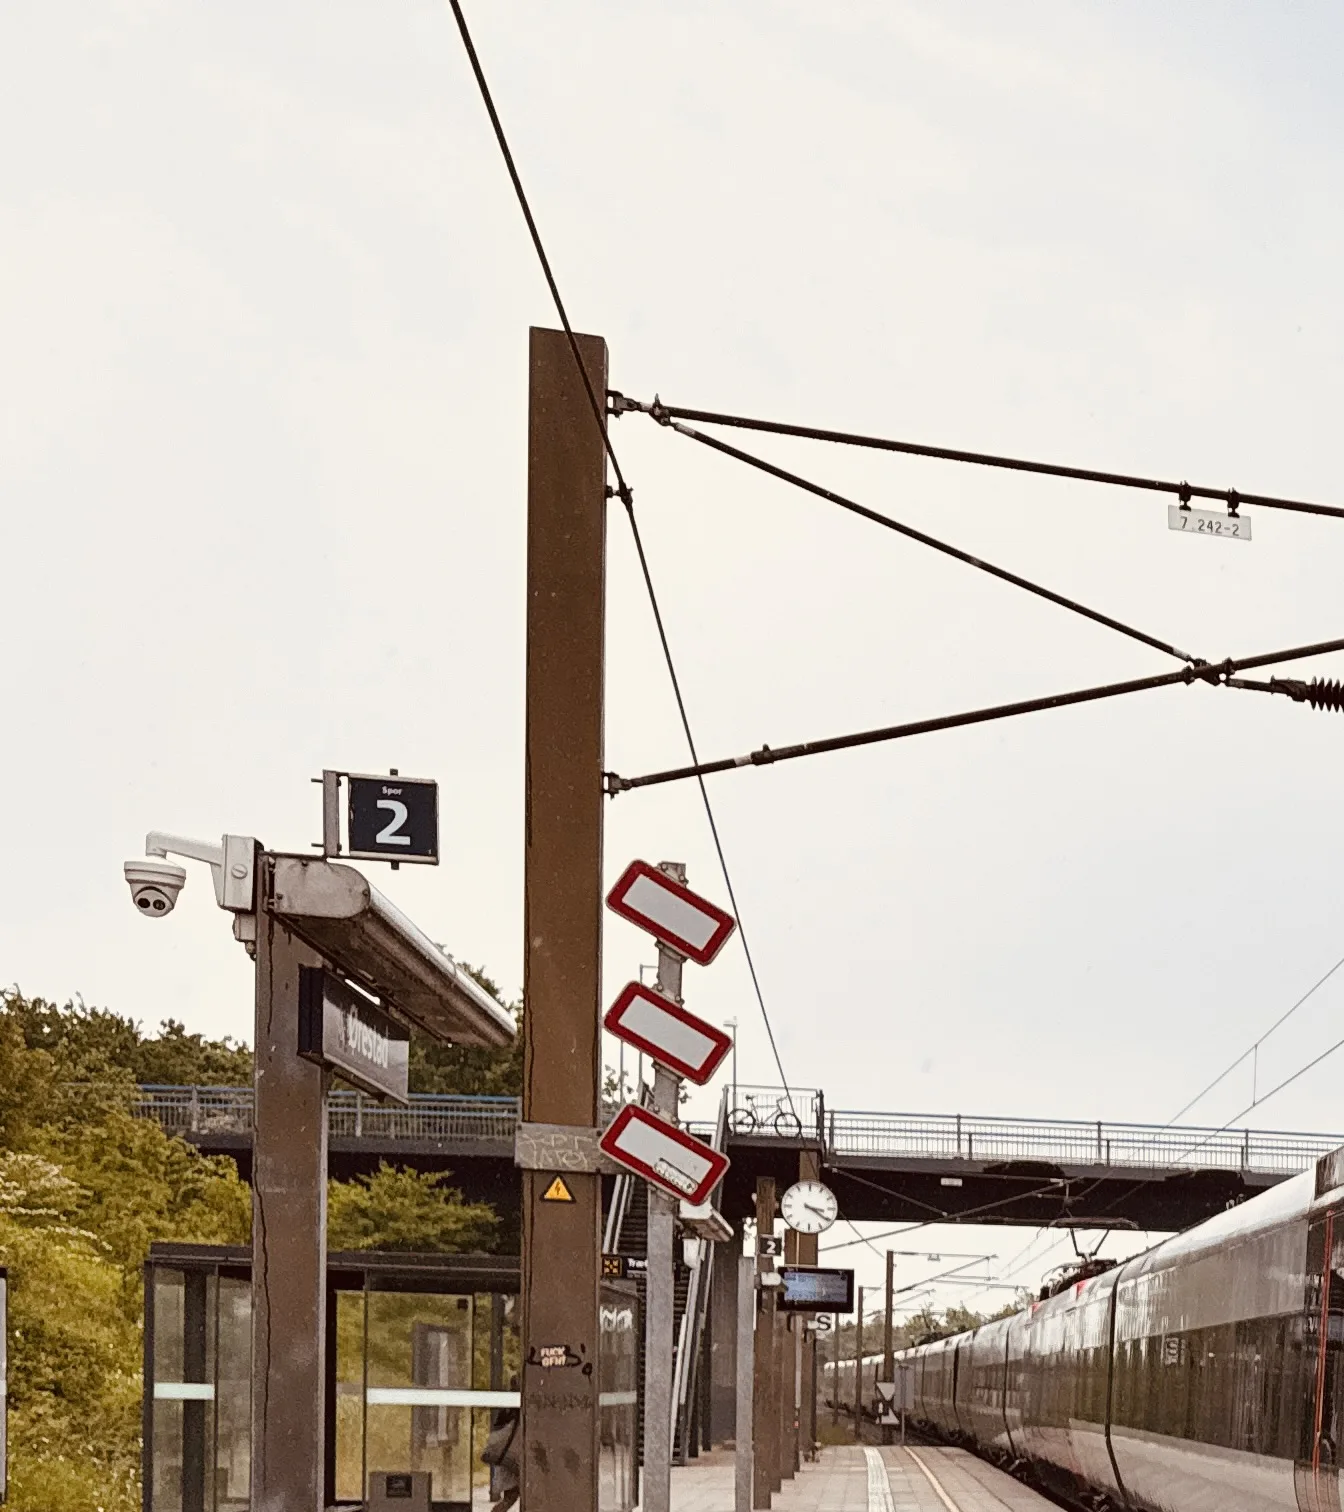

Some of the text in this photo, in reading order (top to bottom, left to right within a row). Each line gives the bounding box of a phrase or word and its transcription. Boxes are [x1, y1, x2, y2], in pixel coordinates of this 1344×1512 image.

[375, 799, 411, 846] 2
[766, 1240, 776, 1254] 2
[816, 1314, 832, 1331] S
